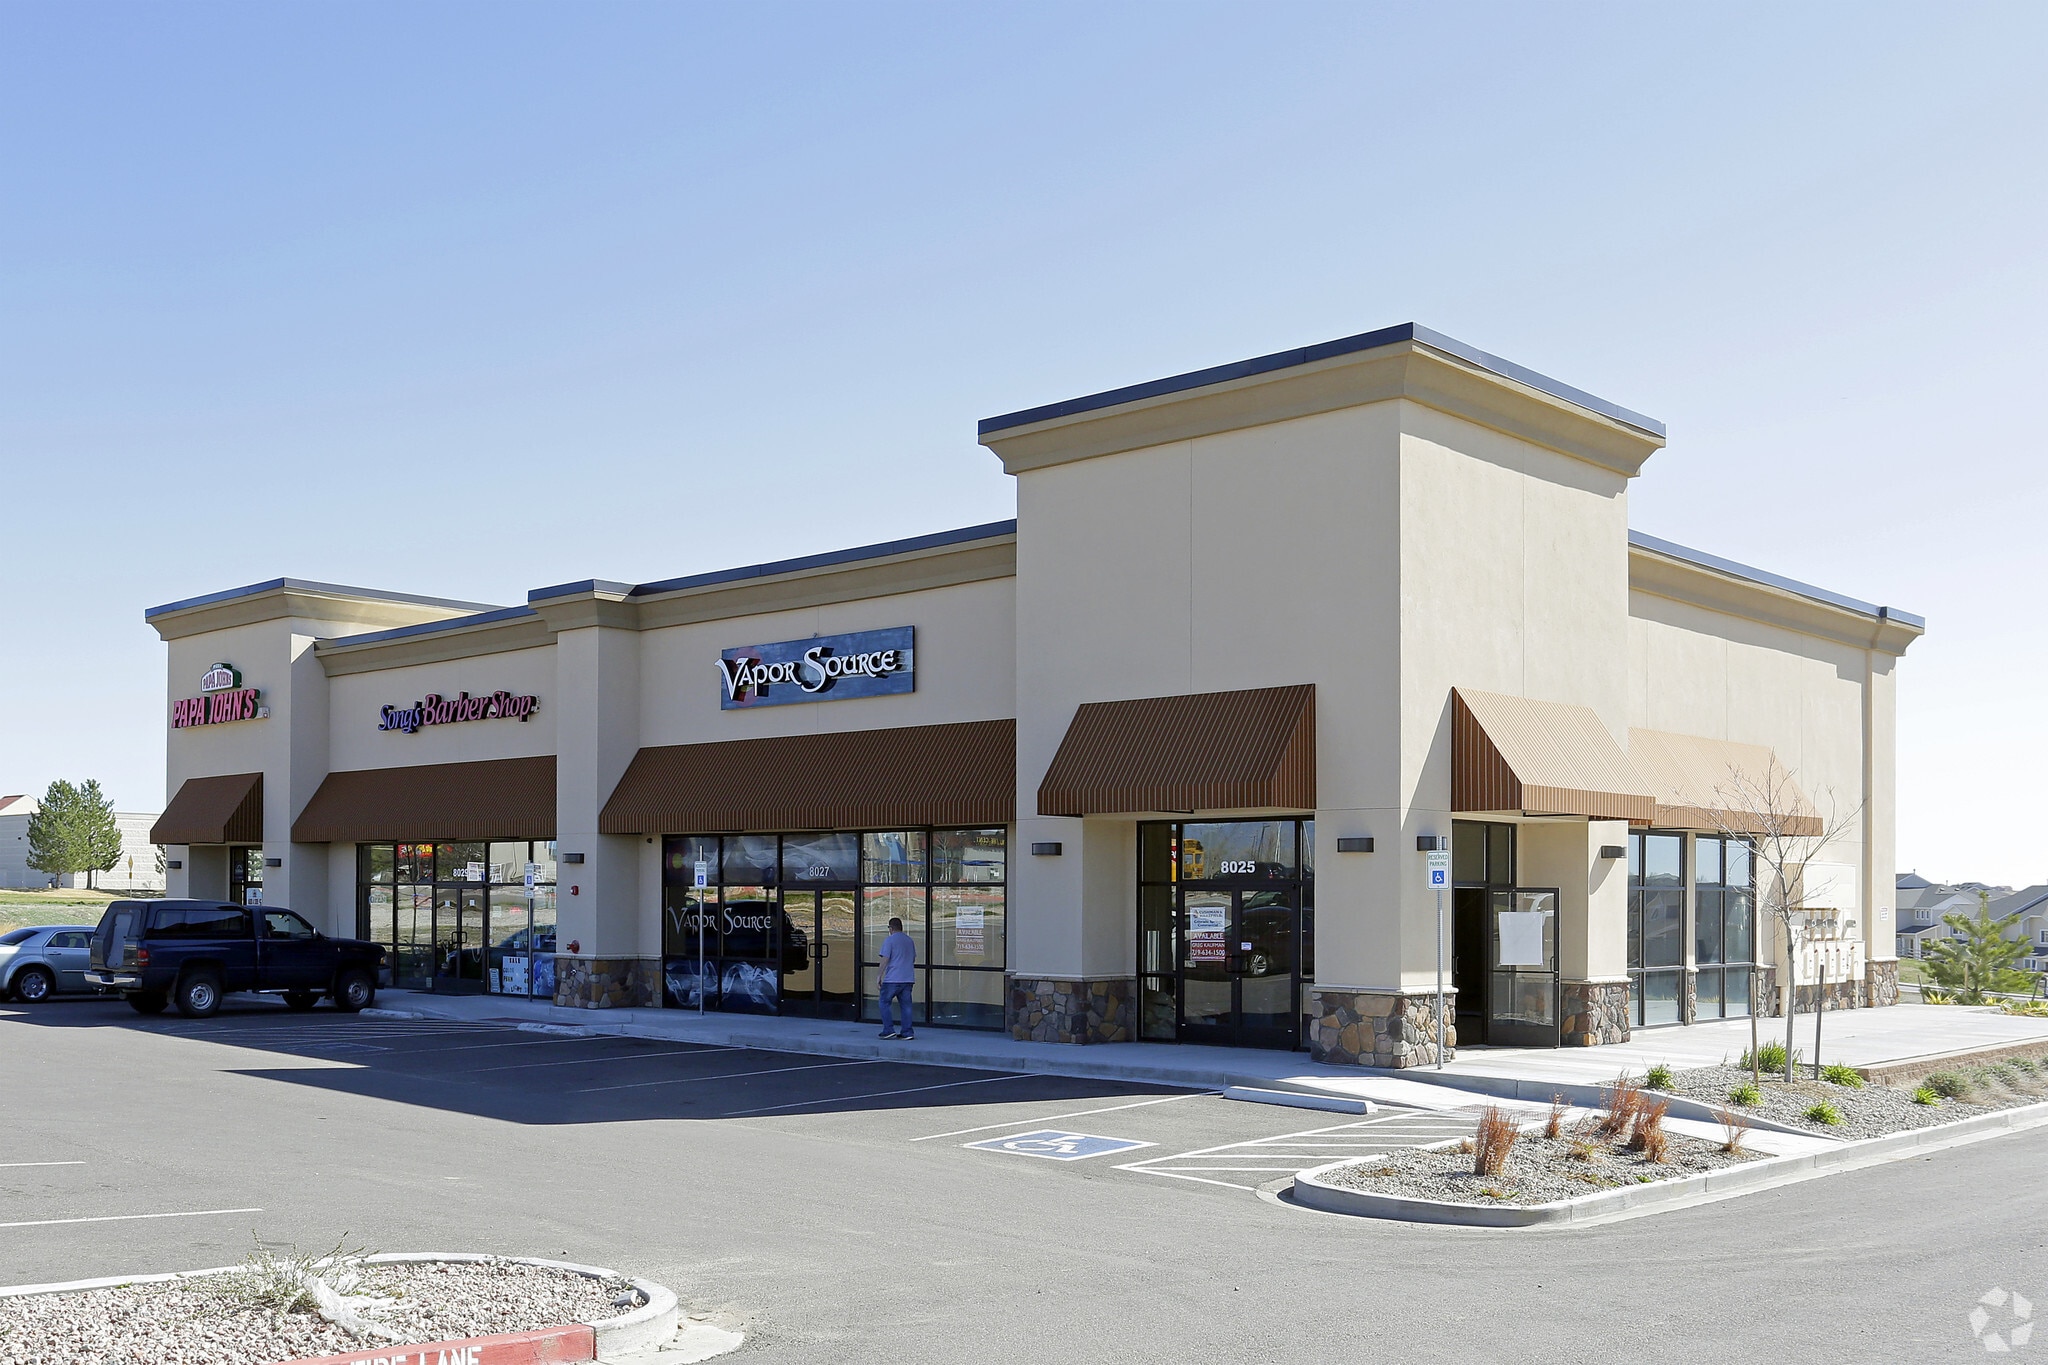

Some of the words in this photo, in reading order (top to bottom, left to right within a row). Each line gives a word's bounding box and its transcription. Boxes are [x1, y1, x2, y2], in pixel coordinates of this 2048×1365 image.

[715, 657, 801, 700] VAPOR
[801, 646, 896, 693] SOURCE
[172, 696, 205, 728] PAPA
[209, 688, 256, 724] JOHN'S
[423, 691, 489, 726] Barber
[489, 690, 532, 722] Shop
[809, 866, 830, 877] 8027
[1220, 860, 1256, 874] 8025
[721, 907, 773, 936] SOURCE
[1193, 932, 1225, 940] AVAILABLE
